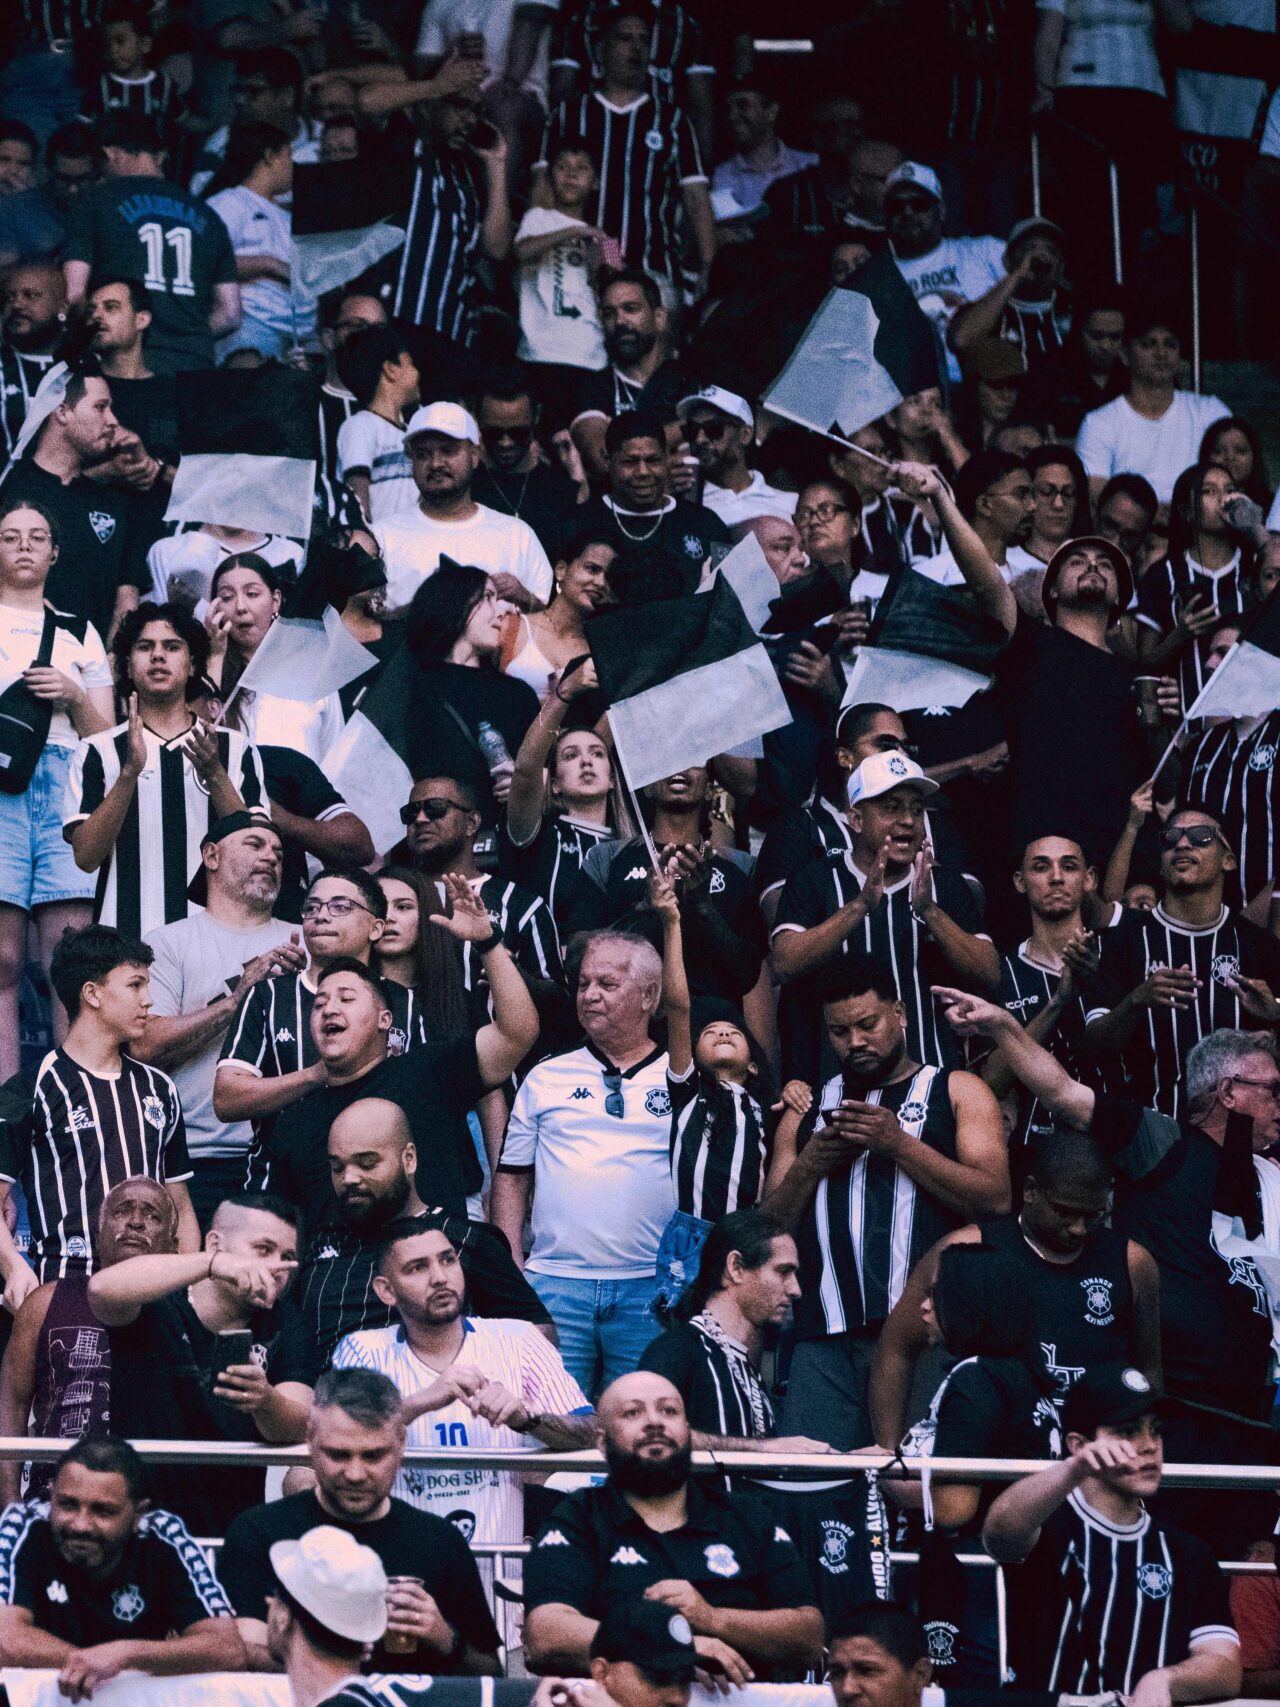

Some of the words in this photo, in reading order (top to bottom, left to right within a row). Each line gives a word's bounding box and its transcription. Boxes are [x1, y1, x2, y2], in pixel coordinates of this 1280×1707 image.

[137, 222, 196, 297] 11
[1080, 1277, 1114, 1290] COMANDO
[426, 1473, 460, 1490] DOG
[869, 1551, 886, 1600] ANDO
